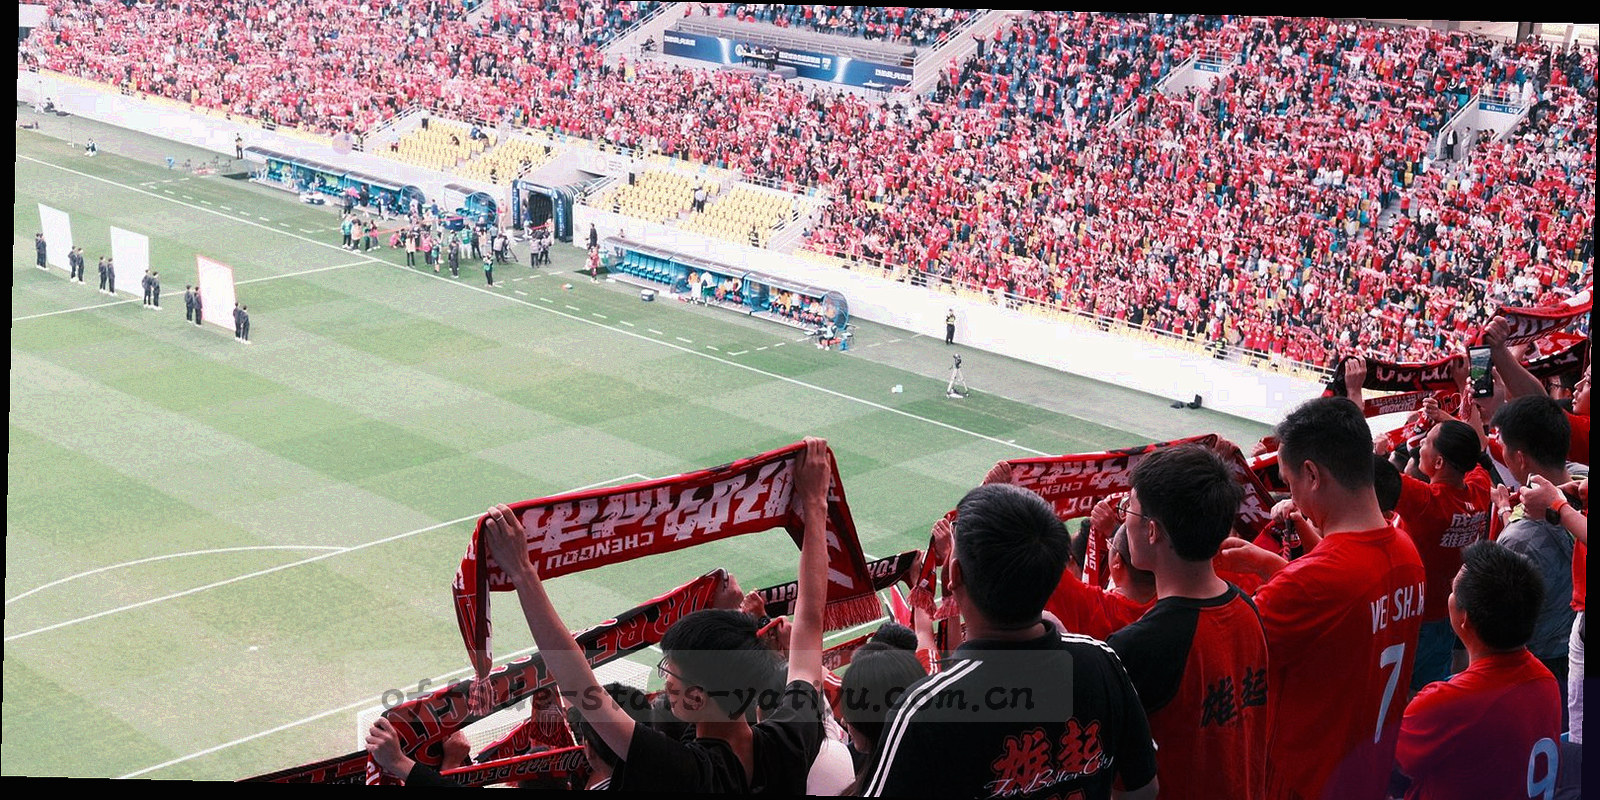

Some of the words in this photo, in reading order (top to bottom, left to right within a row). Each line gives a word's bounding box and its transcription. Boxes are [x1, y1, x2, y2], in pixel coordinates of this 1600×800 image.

[1040, 482, 1082, 497] CHEN
[546, 531, 654, 569] CHENGDU
[1375, 642, 1405, 744] 7
[1526, 737, 1559, 800] 9
